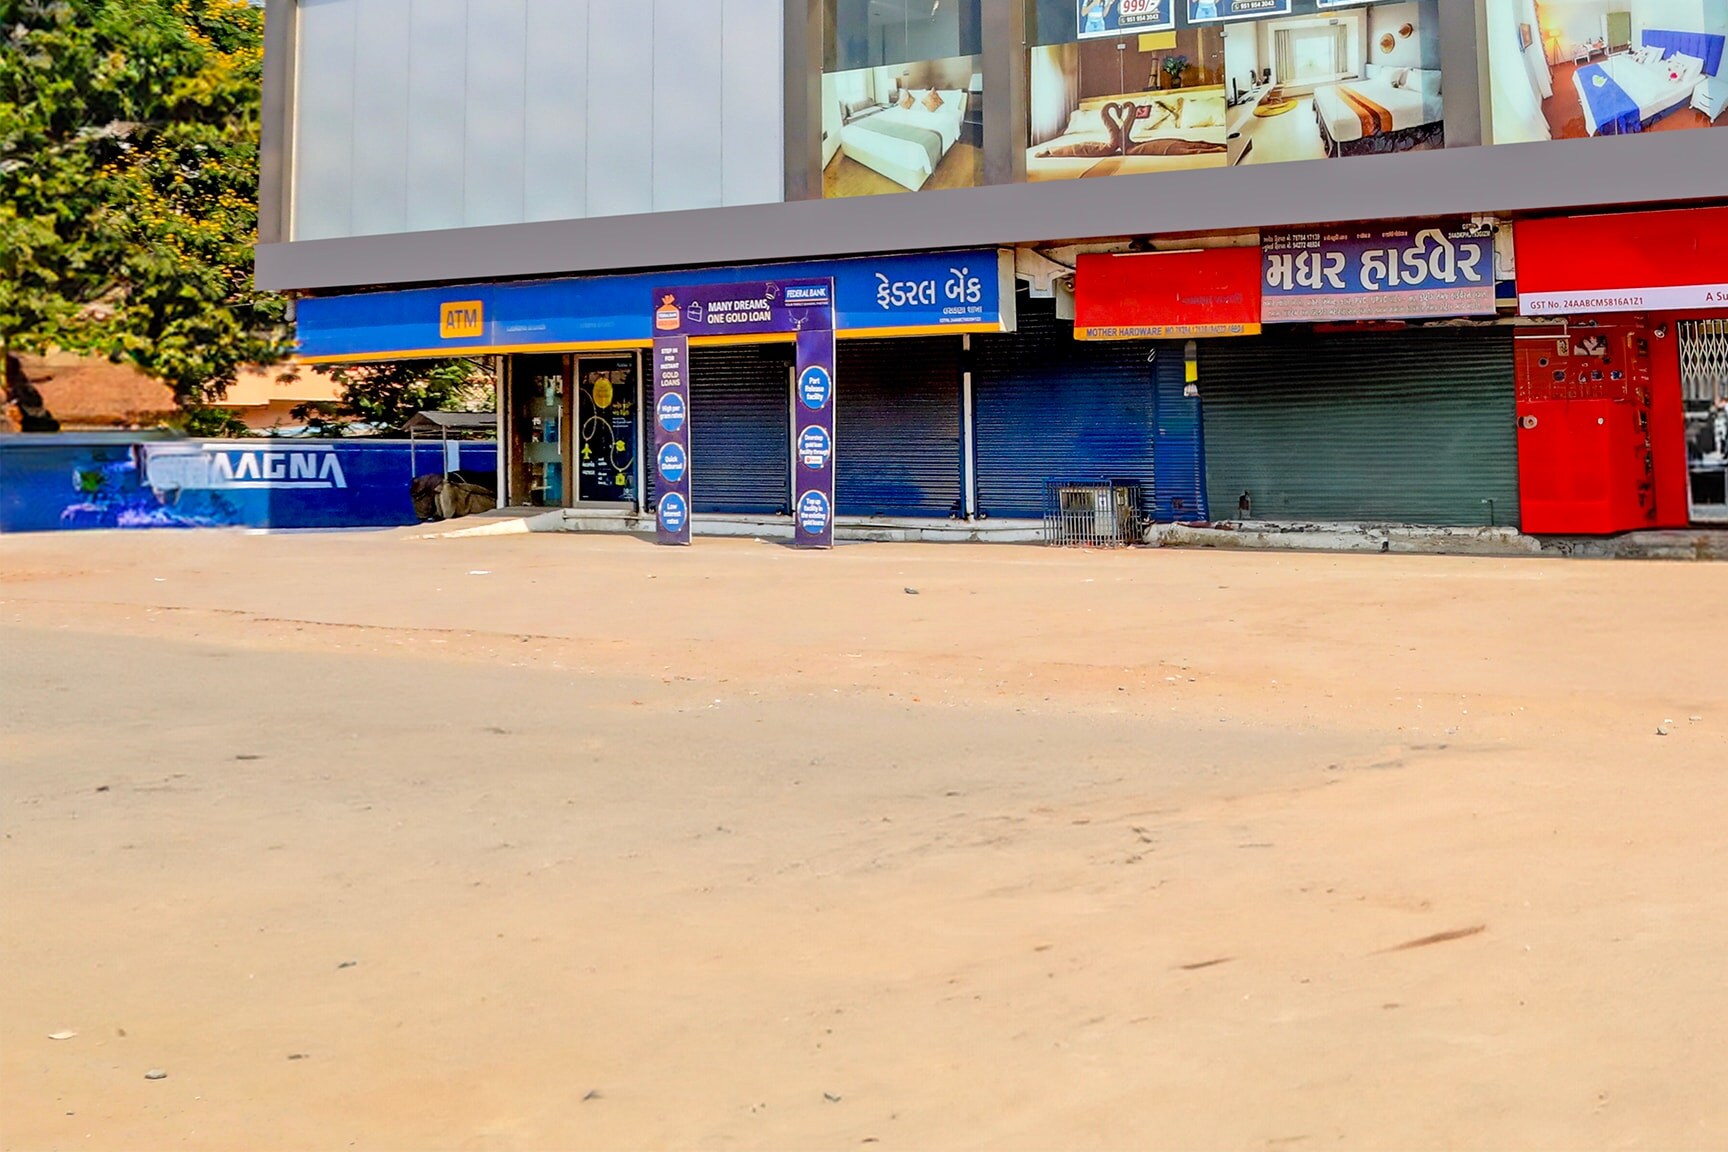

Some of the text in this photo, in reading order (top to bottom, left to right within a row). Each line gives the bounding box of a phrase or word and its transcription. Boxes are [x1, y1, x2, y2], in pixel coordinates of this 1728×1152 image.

[875, 272, 936, 309] ફેડરલ
[1706, 292, 1714, 301] A
[708, 299, 770, 312] MANY DREAMS,
[1530, 301, 1545, 309] GST
[446, 309, 477, 330] ATM
[708, 311, 771, 324] ONE GOLD LOAN
[1086, 328, 1118, 337] MOTHER
[1118, 327, 1162, 336] HARDWARE
[662, 371, 679, 379] GOLD
